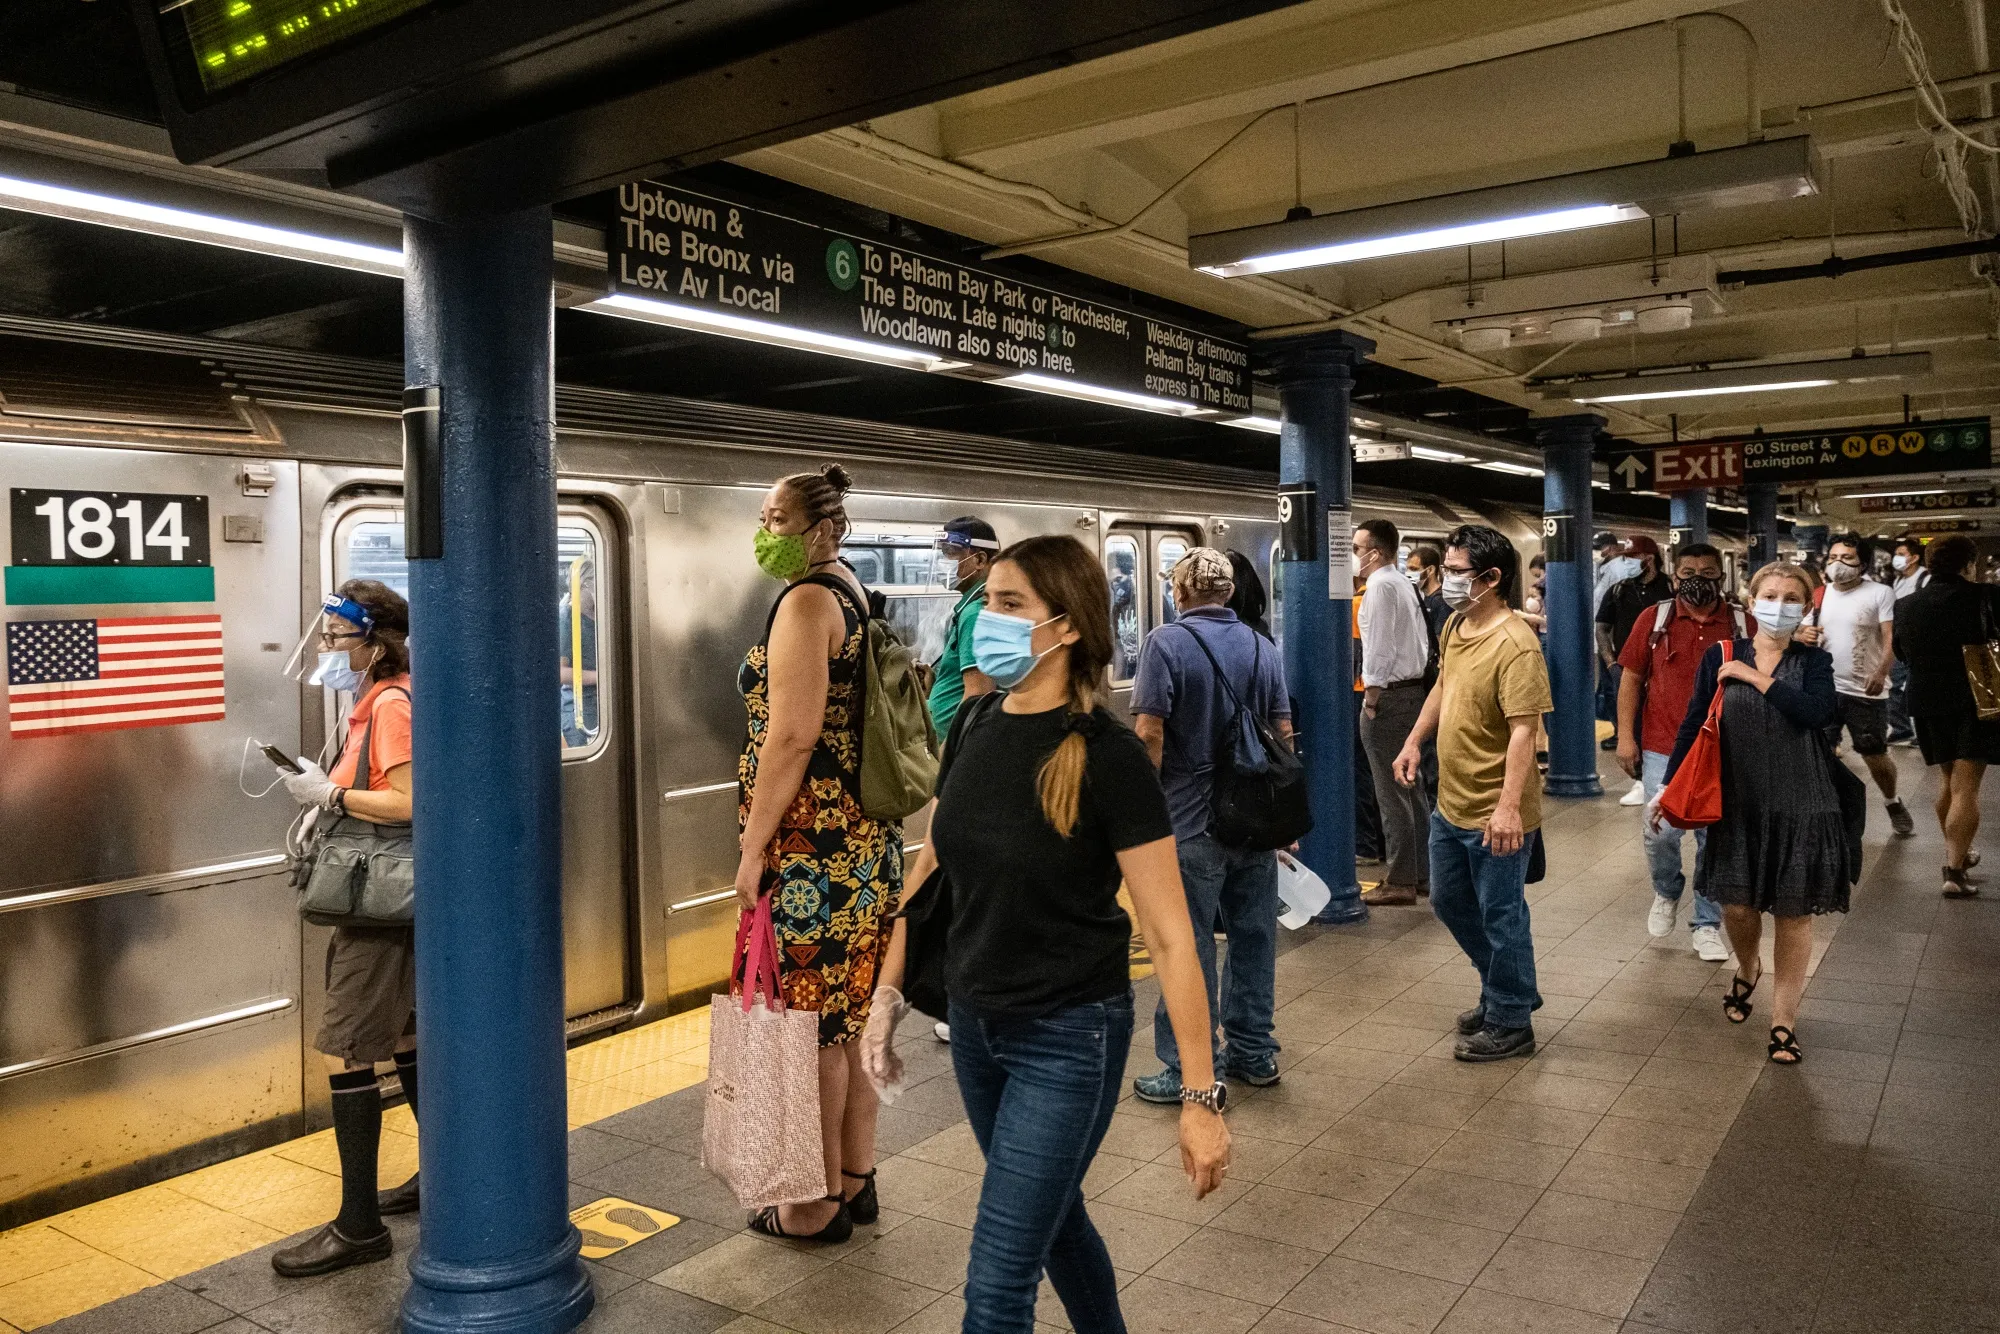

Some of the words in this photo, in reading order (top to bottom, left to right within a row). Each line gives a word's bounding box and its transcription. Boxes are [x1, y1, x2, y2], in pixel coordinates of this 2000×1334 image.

[619, 182, 717, 233] Uptown
[726, 208, 744, 239] &
[620, 216, 671, 256] The
[681, 230, 751, 275] Bronx
[762, 254, 795, 284] via
[835, 250, 850, 280] 6
[620, 253, 668, 292] Lex
[679, 267, 709, 299] Av
[718, 274, 780, 314] Local
[861, 244, 883, 274] To
[890, 252, 952, 291] Pelham
[959, 270, 988, 304] Bay
[994, 280, 1026, 311] Park
[1032, 296, 1047, 315] or
[1052, 296, 1130, 341] Parkchester,
[860, 275, 896, 307] The
[903, 287, 957, 321] Bronx.
[963, 301, 997, 330] Late
[1002, 314, 1045, 342] nights
[1062, 326, 1076, 348] to
[860, 306, 951, 349] Woodlawn
[957, 329, 990, 357] also
[996, 340, 1037, 368] stops
[1042, 350, 1075, 374] here.
[1146, 321, 1194, 356] Weekday
[1197, 338, 1247, 367] afternoons
[1145, 345, 1183, 373] Pelham
[1187, 356, 1206, 382] Bay
[1208, 363, 1234, 386] trains
[1145, 373, 1187, 397] express
[1190, 379, 1199, 399] in
[1202, 382, 1220, 404] The
[1223, 387, 1250, 409] Bronx
[1744, 444, 1764, 456] 60
[1770, 440, 1814, 454] Street
[1820, 438, 1832, 450] &
[1744, 454, 1815, 469] Lexington
[1820, 452, 1838, 464] Av
[1849, 441, 1861, 455] N
[1878, 439, 1889, 451] R
[1902, 436, 1919, 449] W
[1933, 433, 1946, 447] 4
[1964, 431, 1977, 445] 5
[1655, 446, 1739, 484] Exit
[35, 496, 190, 561] 1814
[1278, 496, 1292, 523] 9
